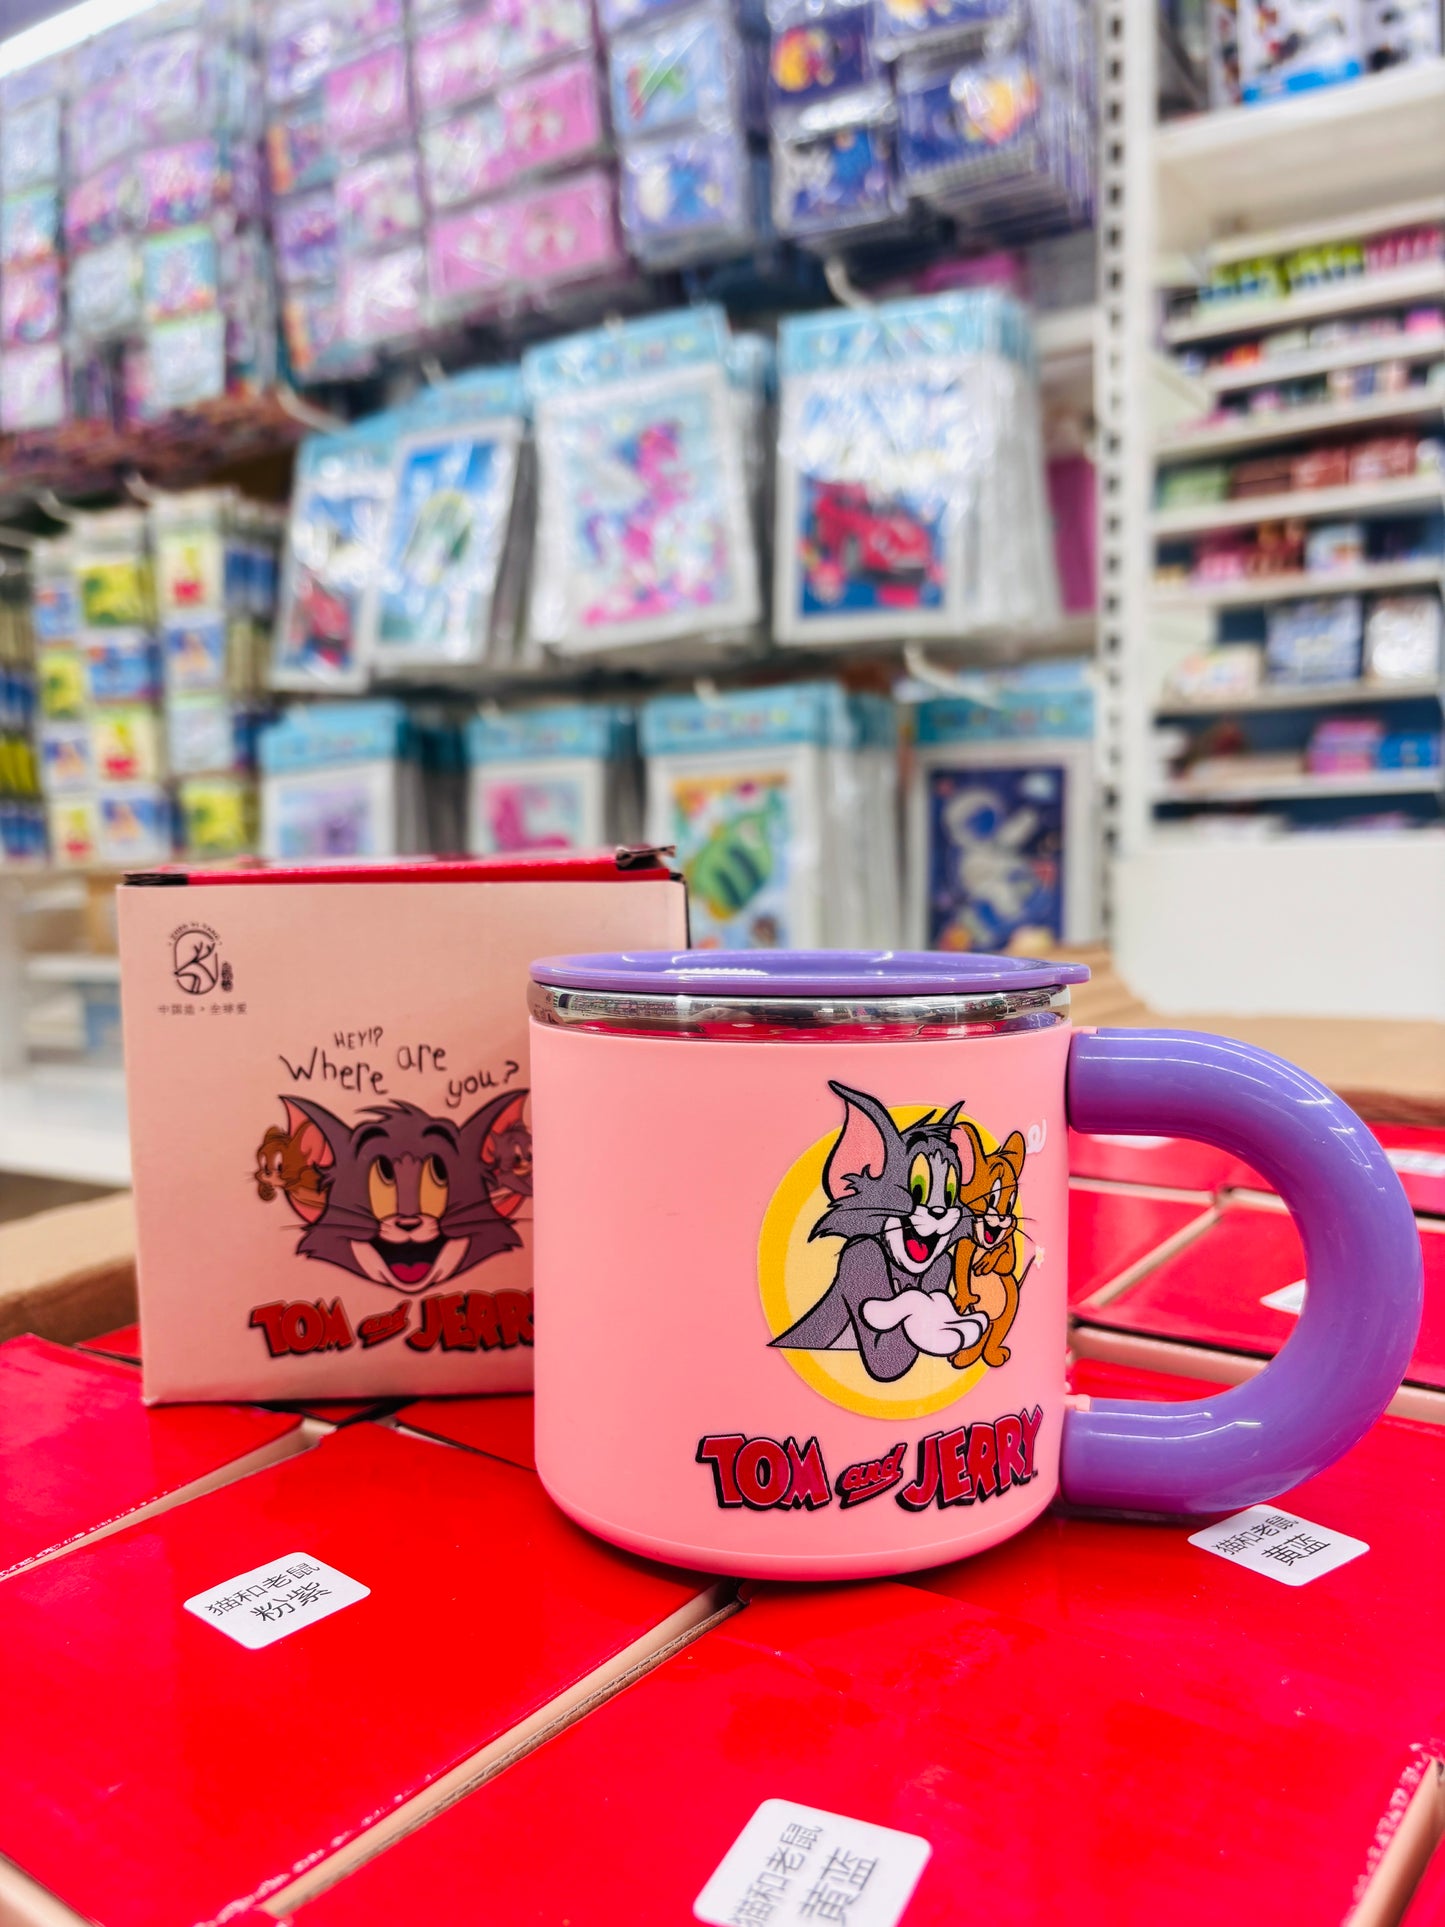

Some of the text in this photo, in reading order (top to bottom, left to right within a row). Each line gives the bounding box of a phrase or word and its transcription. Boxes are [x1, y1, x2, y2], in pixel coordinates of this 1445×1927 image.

[334, 1026, 384, 1050] HEY!?
[279, 1044, 520, 1108] Where are you?
[248, 1288, 534, 1358] TOM and JERR
[695, 1404, 1044, 1513] TOM and JERRY
[1211, 1515, 1300, 1556] 猫和老鼠
[1260, 1533, 1331, 1567] 黄蓝
[205, 1562, 321, 1616] 猫和老鼠
[250, 1581, 333, 1622] 粉紫
[799, 1847, 879, 1927] 黄蓝
